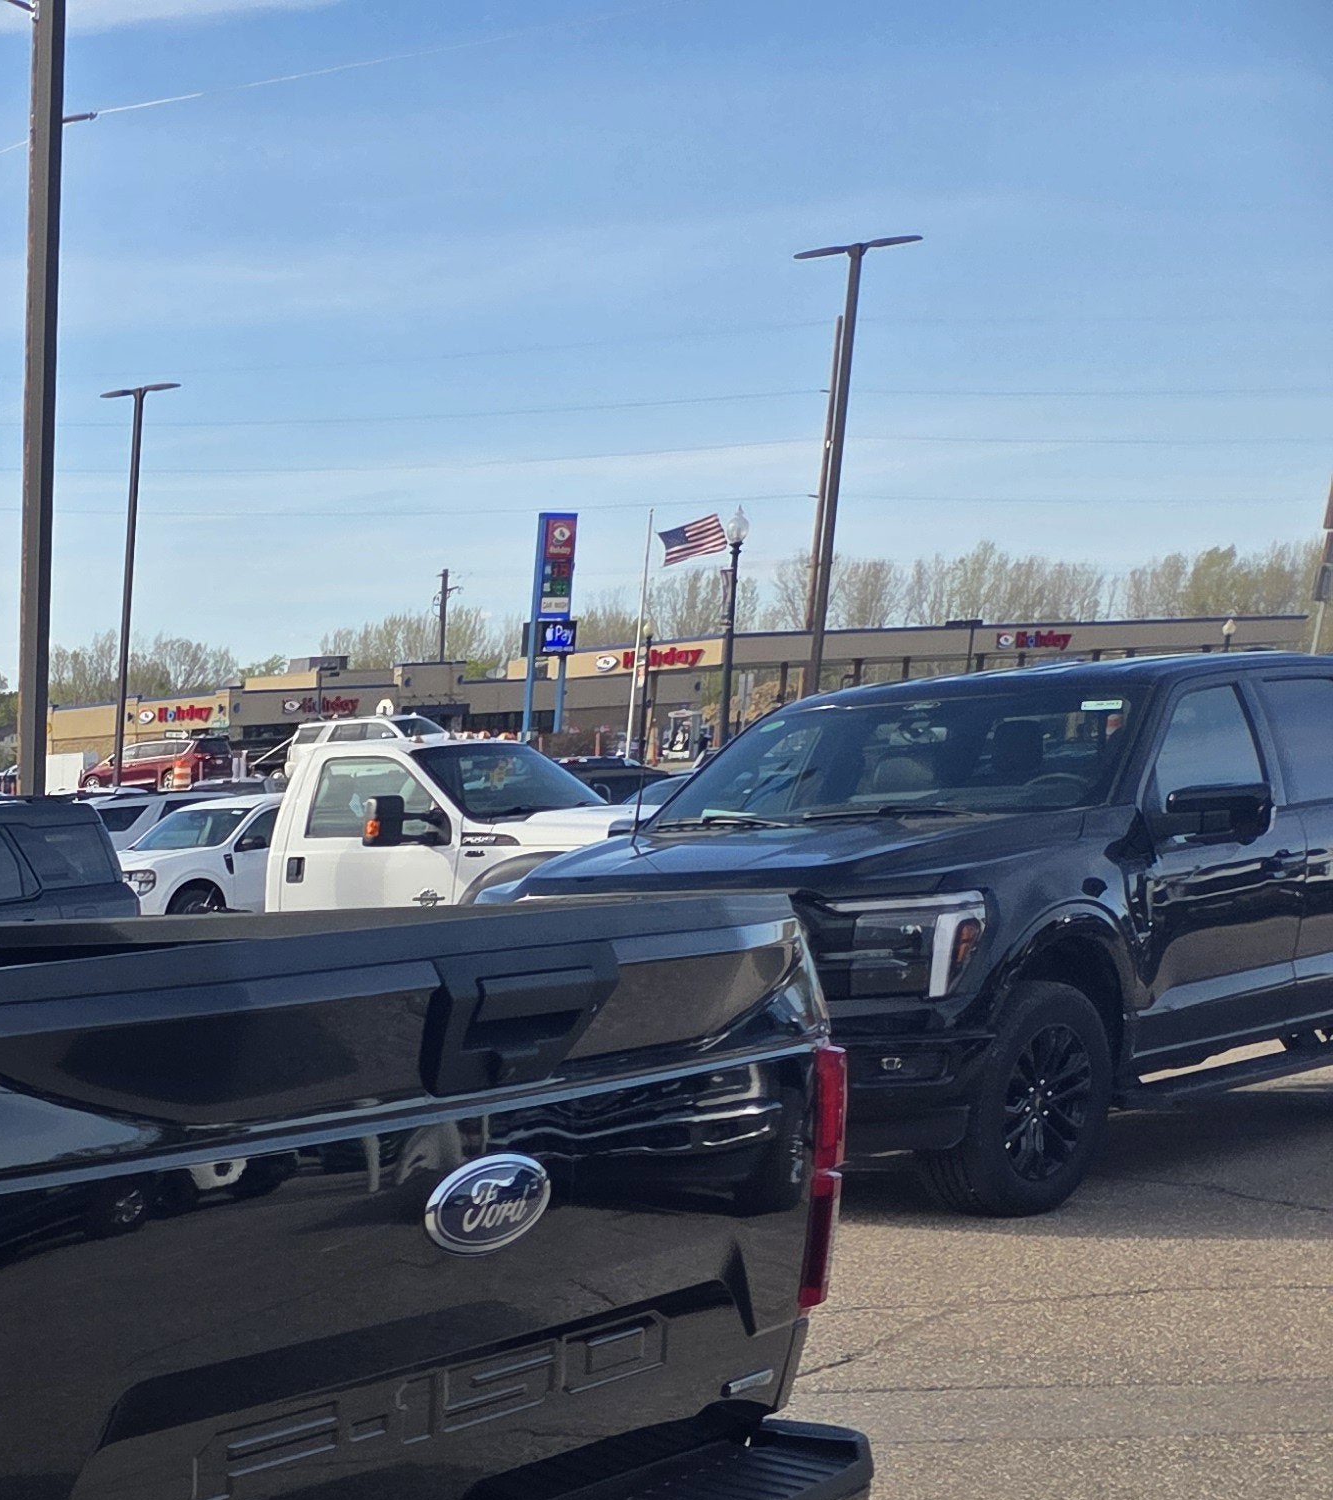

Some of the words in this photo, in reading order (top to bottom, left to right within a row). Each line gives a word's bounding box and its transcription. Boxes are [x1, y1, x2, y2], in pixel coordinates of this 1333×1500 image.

[554, 625, 574, 645] Pay
[1016, 630, 1072, 651] Holiday
[623, 647, 705, 668] Hliday
[158, 705, 214, 723] Holiday
[461, 1176, 530, 1233] Ford
